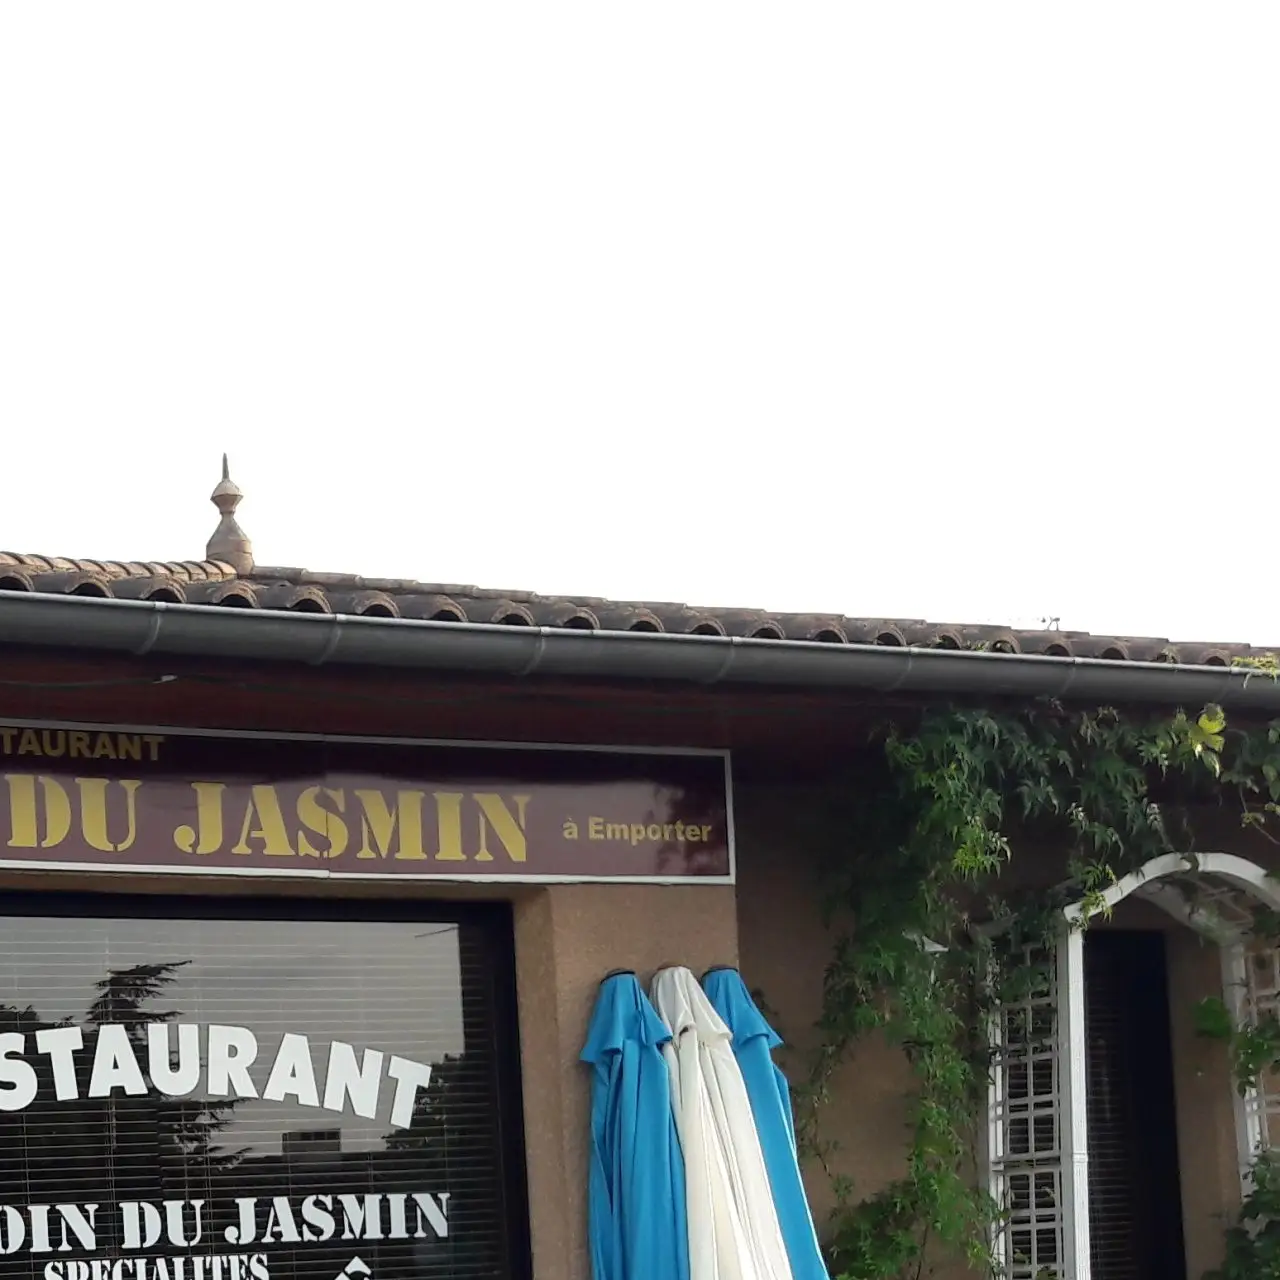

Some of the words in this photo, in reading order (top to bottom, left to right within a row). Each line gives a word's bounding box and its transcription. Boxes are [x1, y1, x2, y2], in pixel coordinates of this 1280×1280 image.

[5, 774, 143, 853] DU
[172, 781, 532, 864] JASMIN
[588, 816, 712, 846] Emporter
[119, 1200, 206, 1249] DU
[224, 1192, 451, 1245] JASMIN
